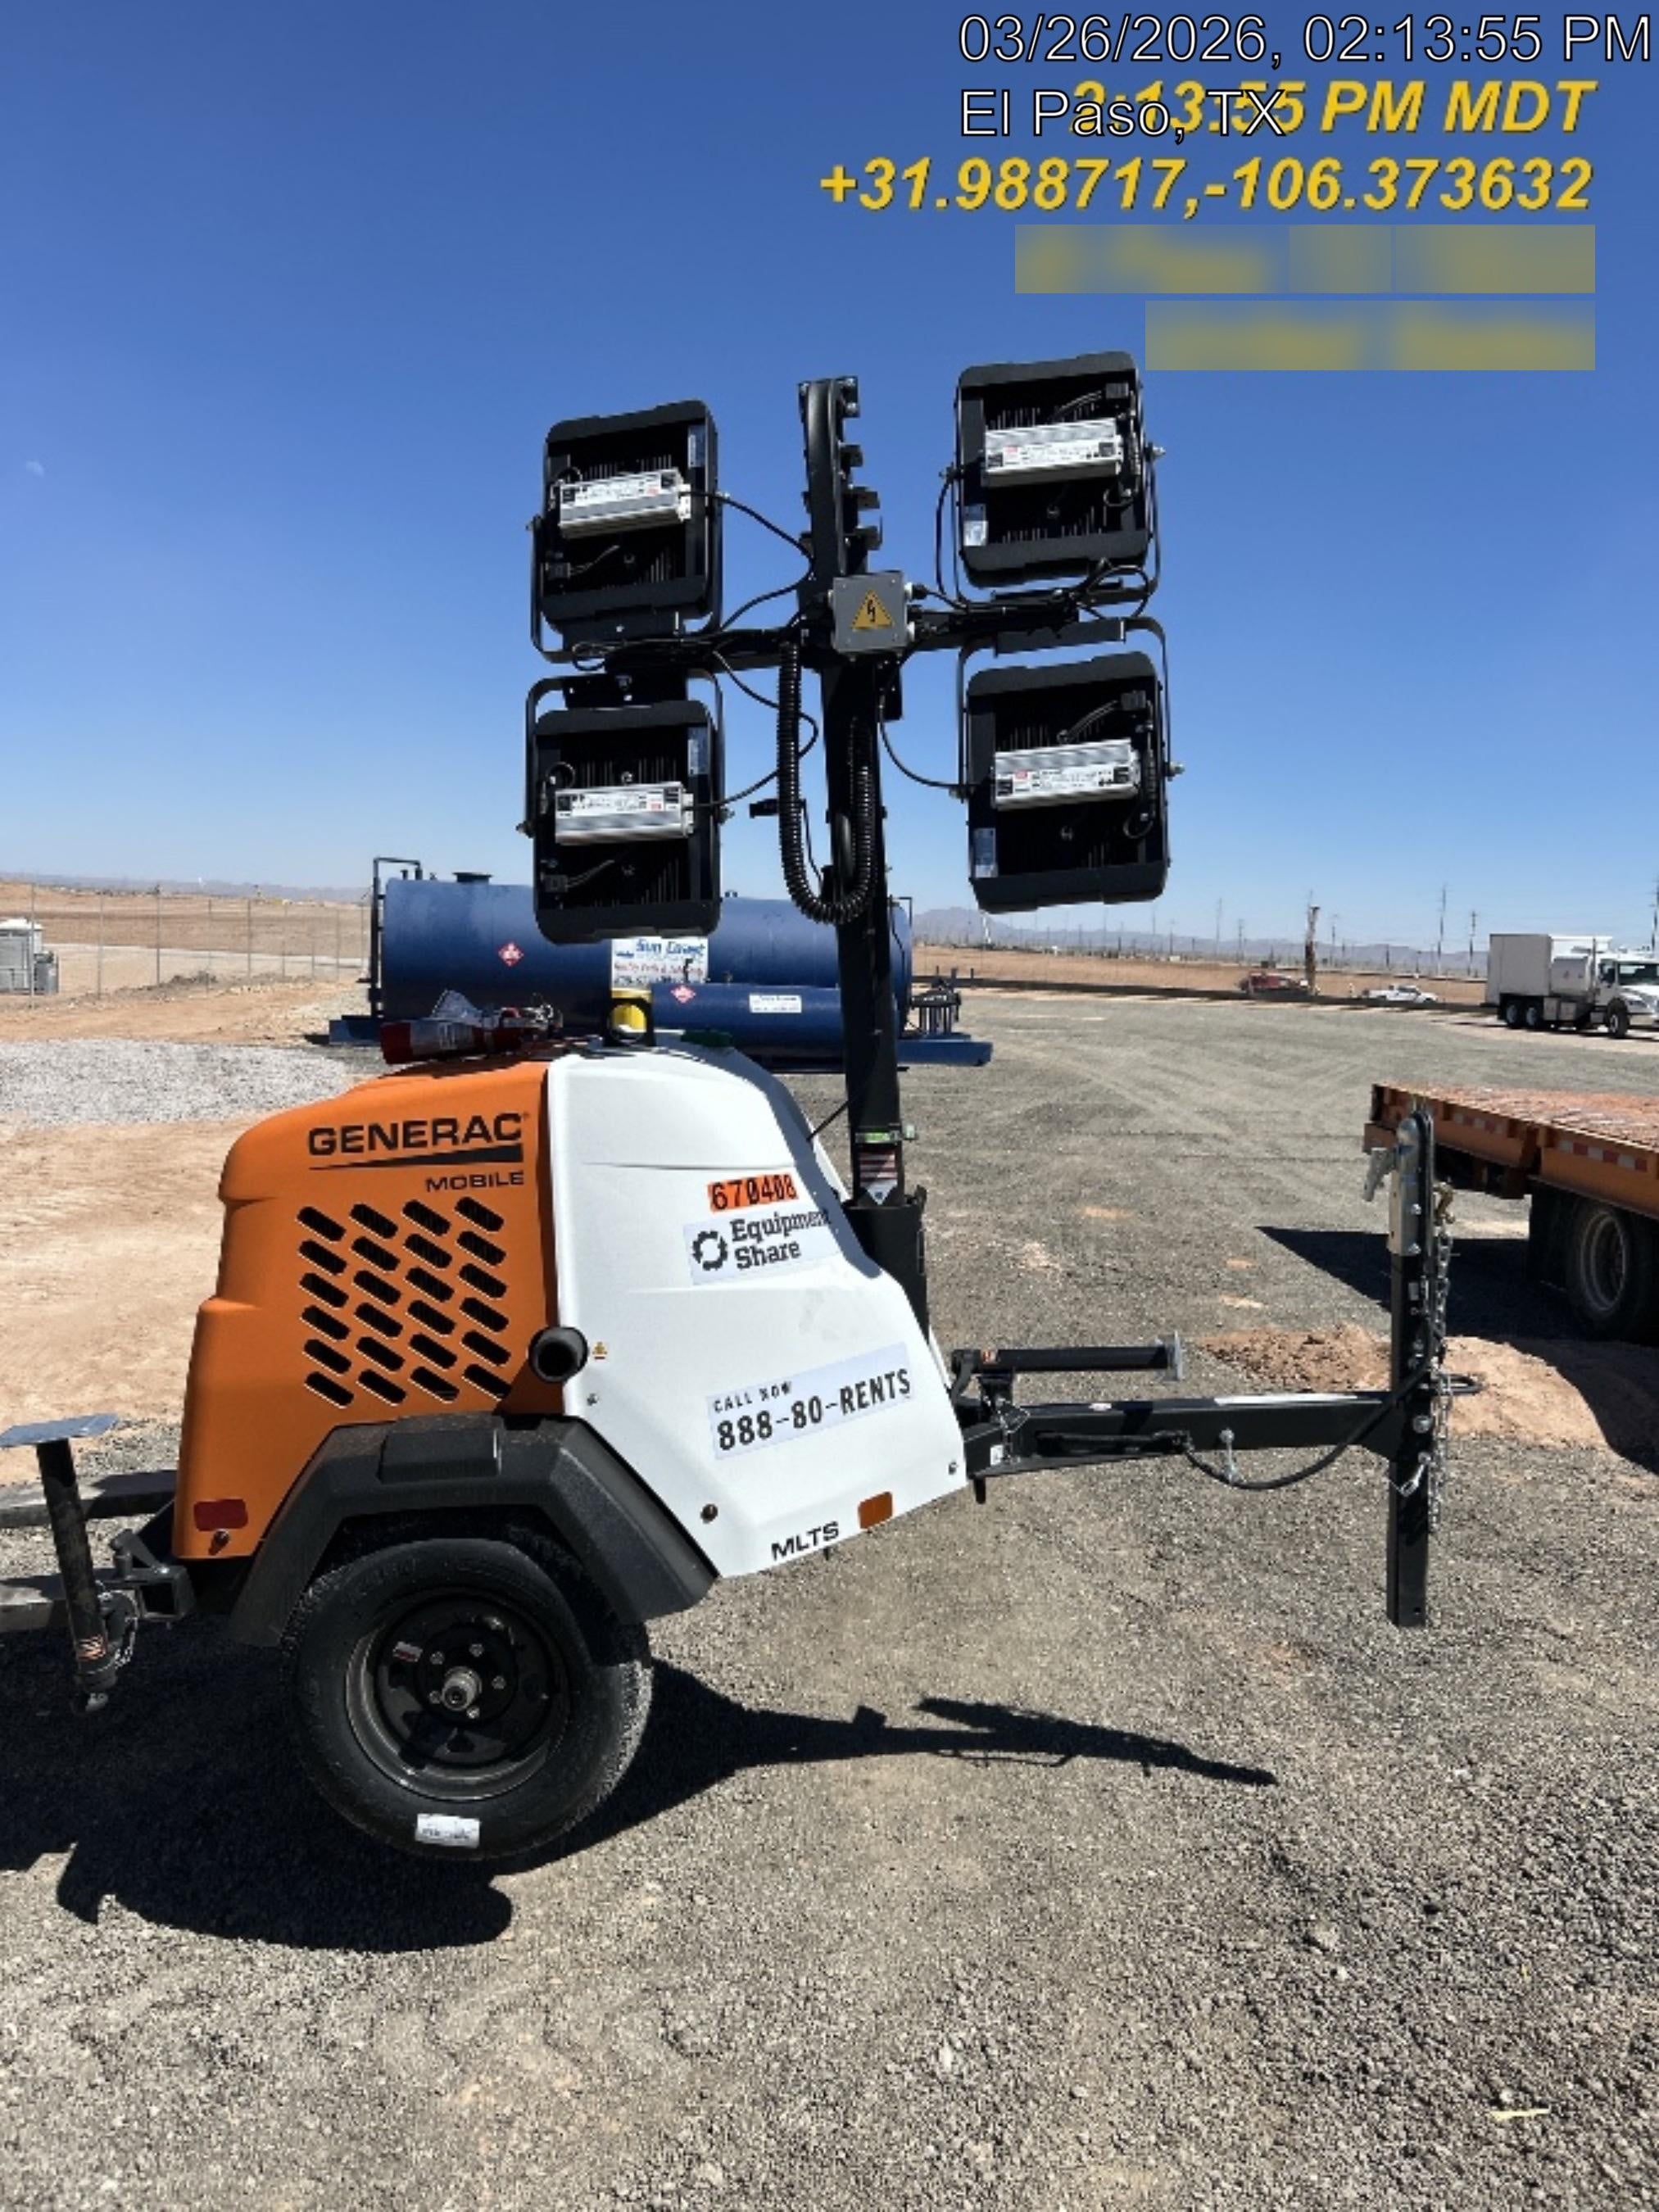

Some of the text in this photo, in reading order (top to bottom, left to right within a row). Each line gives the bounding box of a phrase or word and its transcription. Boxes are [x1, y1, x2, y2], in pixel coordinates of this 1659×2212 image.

[309, 1113, 522, 1156] GENERAC
[425, 1170, 524, 1193] MOBILE
[711, 1174, 797, 1211] 670408
[734, 1240, 802, 1270] Share
[714, 1393, 753, 1413] CALL
[717, 1367, 911, 1451] 888-80-RENTS
[771, 1521, 839, 1562] MLTS
